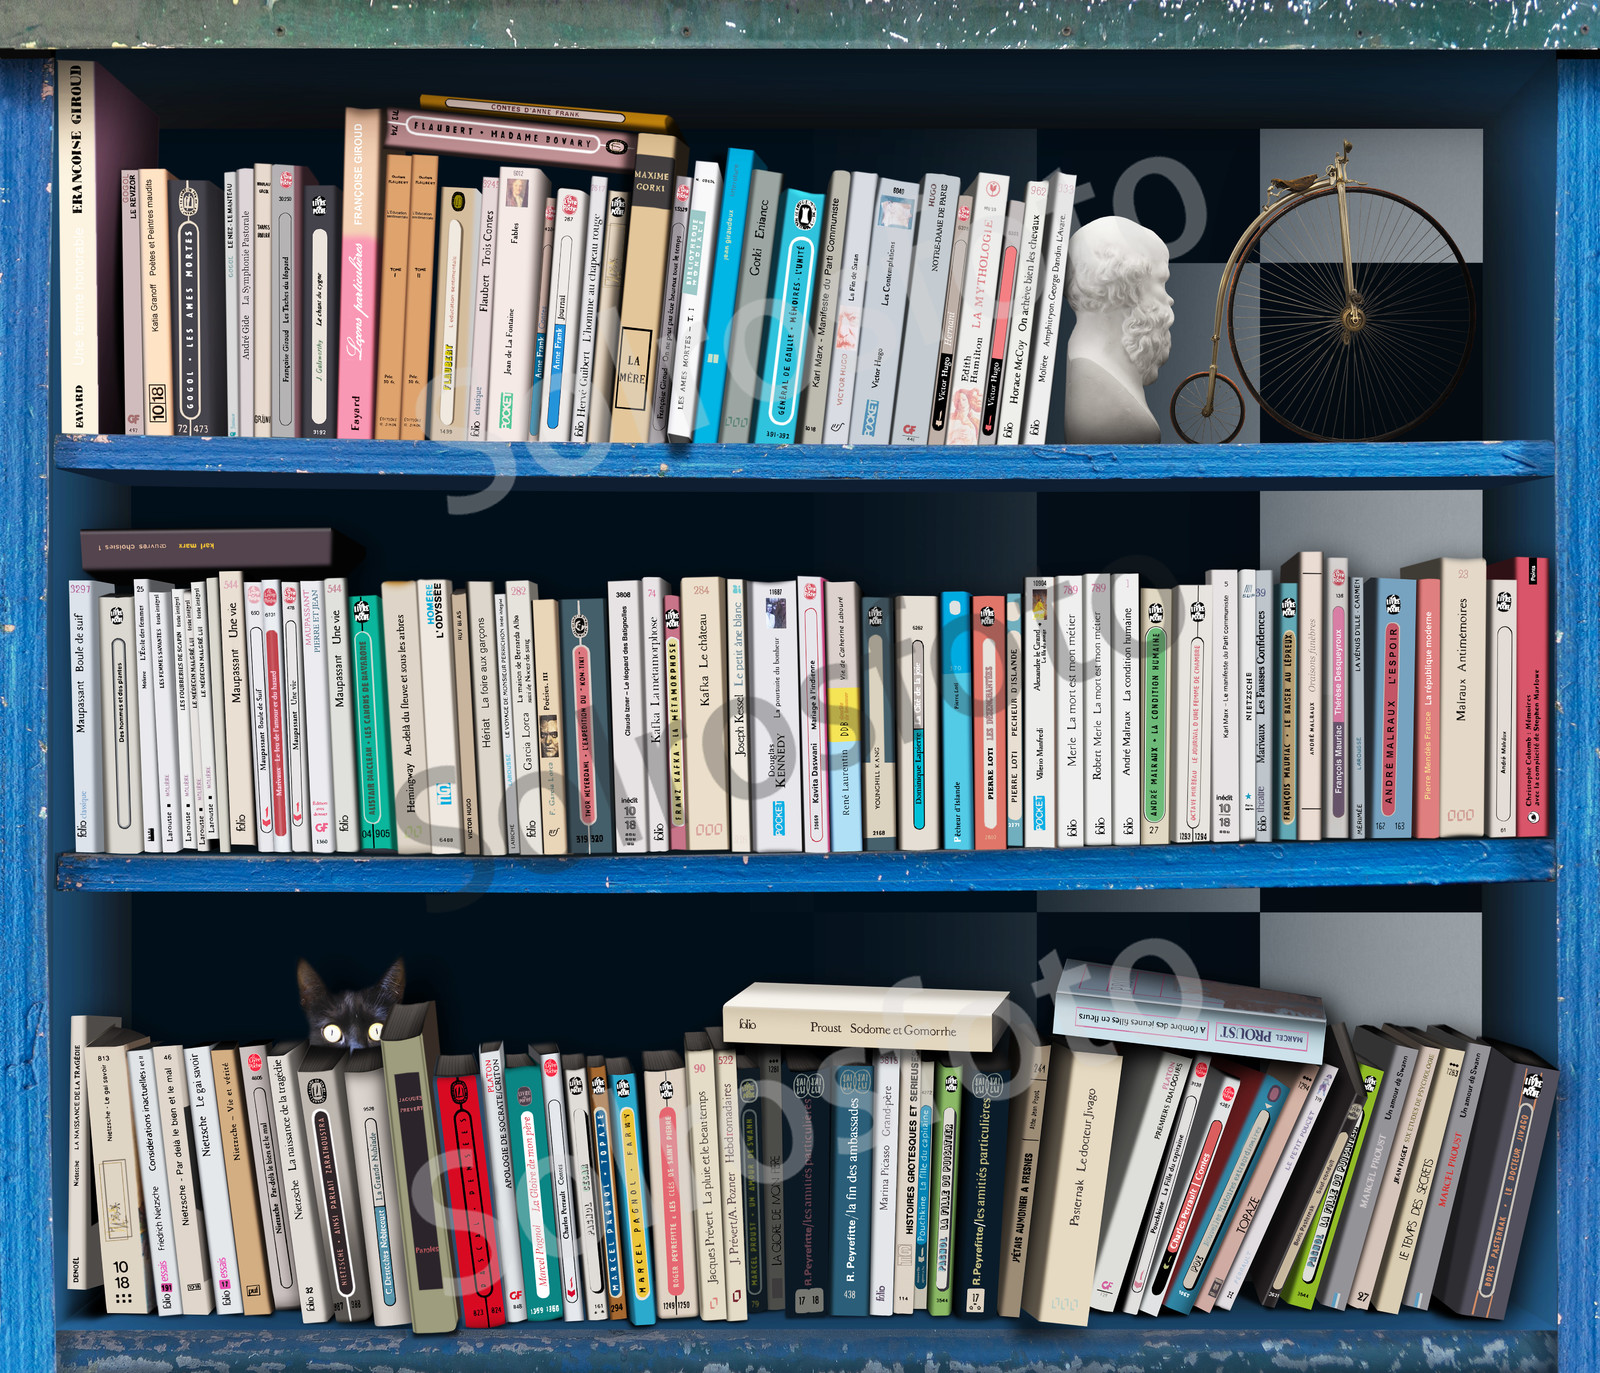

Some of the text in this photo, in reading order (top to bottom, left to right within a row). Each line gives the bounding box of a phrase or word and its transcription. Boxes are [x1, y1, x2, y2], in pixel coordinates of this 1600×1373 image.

[491, 104, 580, 118] CONTES D'ANNE FRANK
[414, 121, 592, 148] FLAUBERT MADAME BOVARY
[354, 123, 365, 225] FRANÇOISE GIROUD
[635, 171, 669, 180] MAXIME
[636, 183, 665, 192] GORKI
[145, 179, 153, 208] maudits
[146, 210, 155, 239] Peintres
[148, 250, 156, 276] Poètes
[242, 211, 252, 360] André Gide La Symphonie Pastorale
[812, 198, 839, 388] Karl Marx Manifeste du Parti Communiste
[150, 284, 159, 332] Katia Granoff
[500, 223, 519, 429] POCKET Jean de La Fontaine Fables
[553, 295, 566, 370] Anne Frank Journal
[863, 241, 896, 436] POCKET Victor Hugo Les Contemplations
[961, 355, 971, 381] Edith
[970, 337, 983, 383] Hamilton
[302, 590, 312, 646] MAUPASSANT
[311, 589, 321, 653] PIERRE ET JEAN
[1425, 611, 1433, 648] moderne
[1456, 569, 1469, 722] Malraux Antimémoires 23
[116, 662, 124, 685] plantes
[477, 617, 491, 748] Hériat La foire aux garçons
[732, 602, 747, 757] Joseph Kessel Le petit âne blanc
[1010, 649, 1018, 693] D'ISLANDE
[1424, 650, 1435, 693] république
[224, 580, 247, 832] folio Maupassant Une vie 544
[255, 688, 263, 701] Suif
[257, 702, 264, 710] de
[1334, 629, 1344, 794] François Mauriac Thérèse Desqueyroux
[1425, 695, 1432, 705] La
[1122, 608, 1134, 835] folio André Malraux La condition humaine
[1148, 633, 1160, 835] 27 ANDRÉ MALRAUX LA CONDITION HUMAINE
[1424, 711, 1432, 739] France
[258, 732, 268, 771] Maupassant
[1424, 742, 1432, 774] Mendès
[1525, 737, 1533, 765] Colomb
[1525, 768, 1534, 807] Christophe
[625, 806, 636, 816] 10
[625, 820, 636, 829] 18
[773, 801, 784, 836] POCKET
[739, 1019, 956, 1037] folio Proust Sodome et Gomorrhe
[1078, 1012, 1099, 1023] fleurs
[1112, 1017, 1129, 1027] filles
[1130, 1018, 1155, 1029] jeunes
[1156, 1021, 1168, 1030] des
[1171, 1022, 1198, 1034] l'ombre
[1220, 1025, 1303, 1044] MARCEL PROUST
[485, 1059, 495, 1093] PLATON
[882, 1086, 894, 1136] Grand-père
[880, 1145, 890, 1176] Picasso
[1437, 1131, 1463, 1208] MARCEL PROUST
[317, 1116, 348, 1286] NIETZSCHE AINSI PARLAIT ZARATHOUSTRA
[596, 1114, 619, 1291] MARCEL PAGNOL TOPAZE
[880, 1179, 889, 1211] Marina
[1169, 1152, 1211, 1250] Charles Perrault Contes
[1484, 1114, 1530, 1286] BORIS PASTERNAK LE DOCTEUR JIVAGO
[113, 1261, 128, 1273] 10
[415, 1246, 440, 1254] Paroles
[114, 1276, 130, 1289] 18
